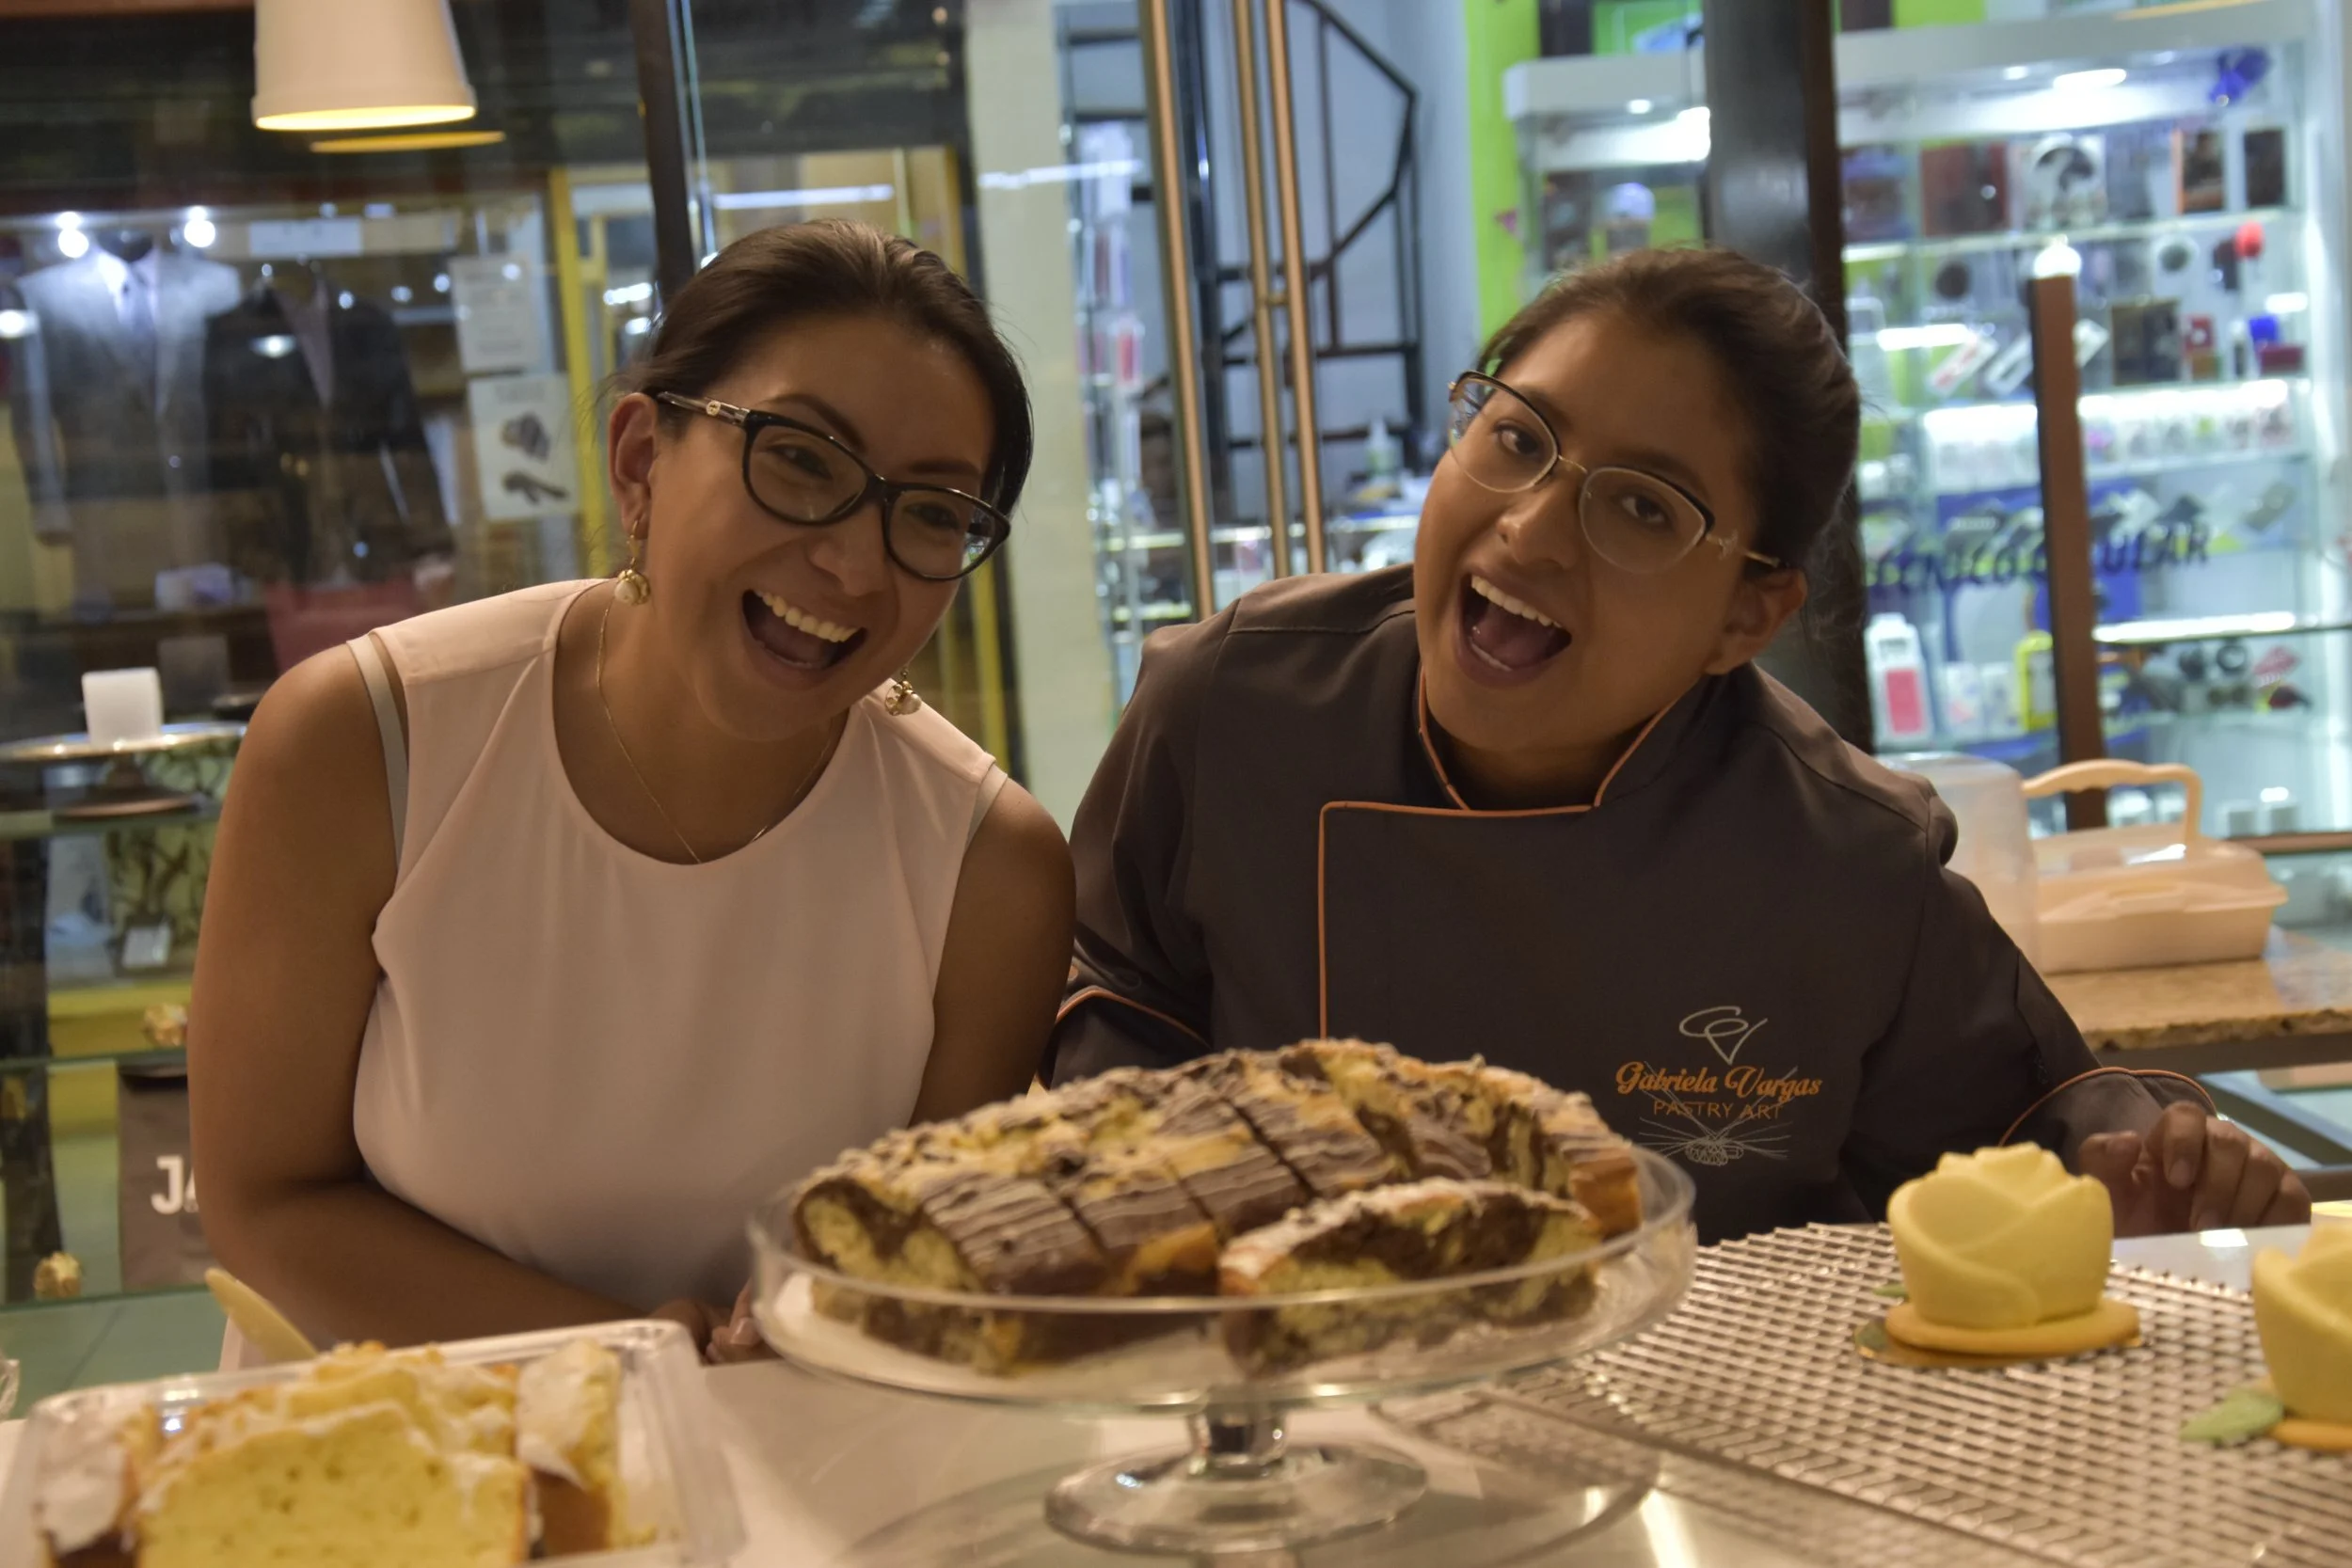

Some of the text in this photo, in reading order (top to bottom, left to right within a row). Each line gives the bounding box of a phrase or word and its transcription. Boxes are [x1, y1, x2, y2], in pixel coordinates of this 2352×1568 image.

[1615, 1060, 1824, 1102] Gabriela Vargas
[1653, 1100, 1784, 1120] PASTRY ART
